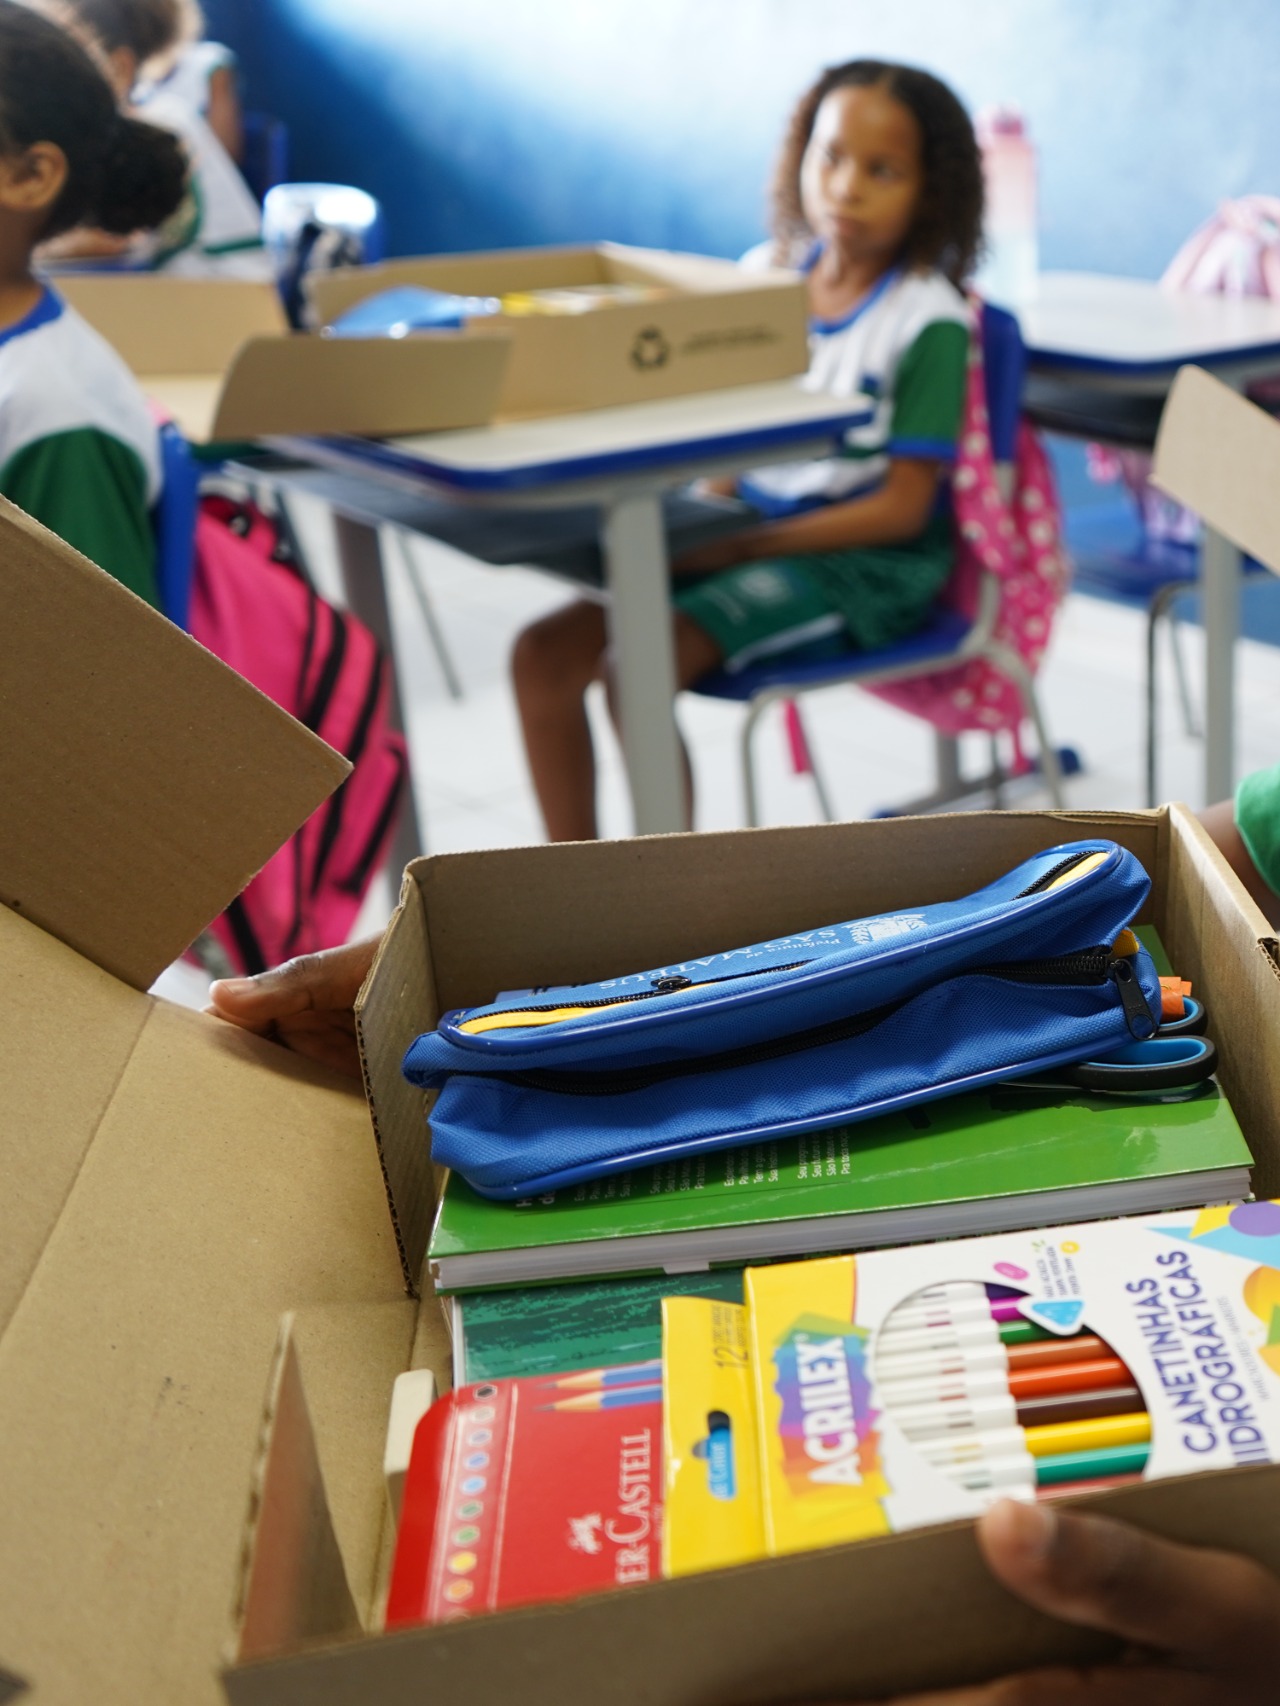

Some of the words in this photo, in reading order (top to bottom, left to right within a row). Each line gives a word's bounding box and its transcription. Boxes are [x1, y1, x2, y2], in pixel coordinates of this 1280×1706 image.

[599, 947, 752, 990] MATEUS
[797, 1166, 807, 1179] Seu
[811, 1165, 822, 1178] Seu
[825, 1163, 837, 1176] São
[841, 1163, 851, 1174] Pra
[714, 1348, 748, 1370] 12
[1125, 1278, 1219, 1454] CANETINHAS
[795, 1336, 864, 1486] ACRILEX
